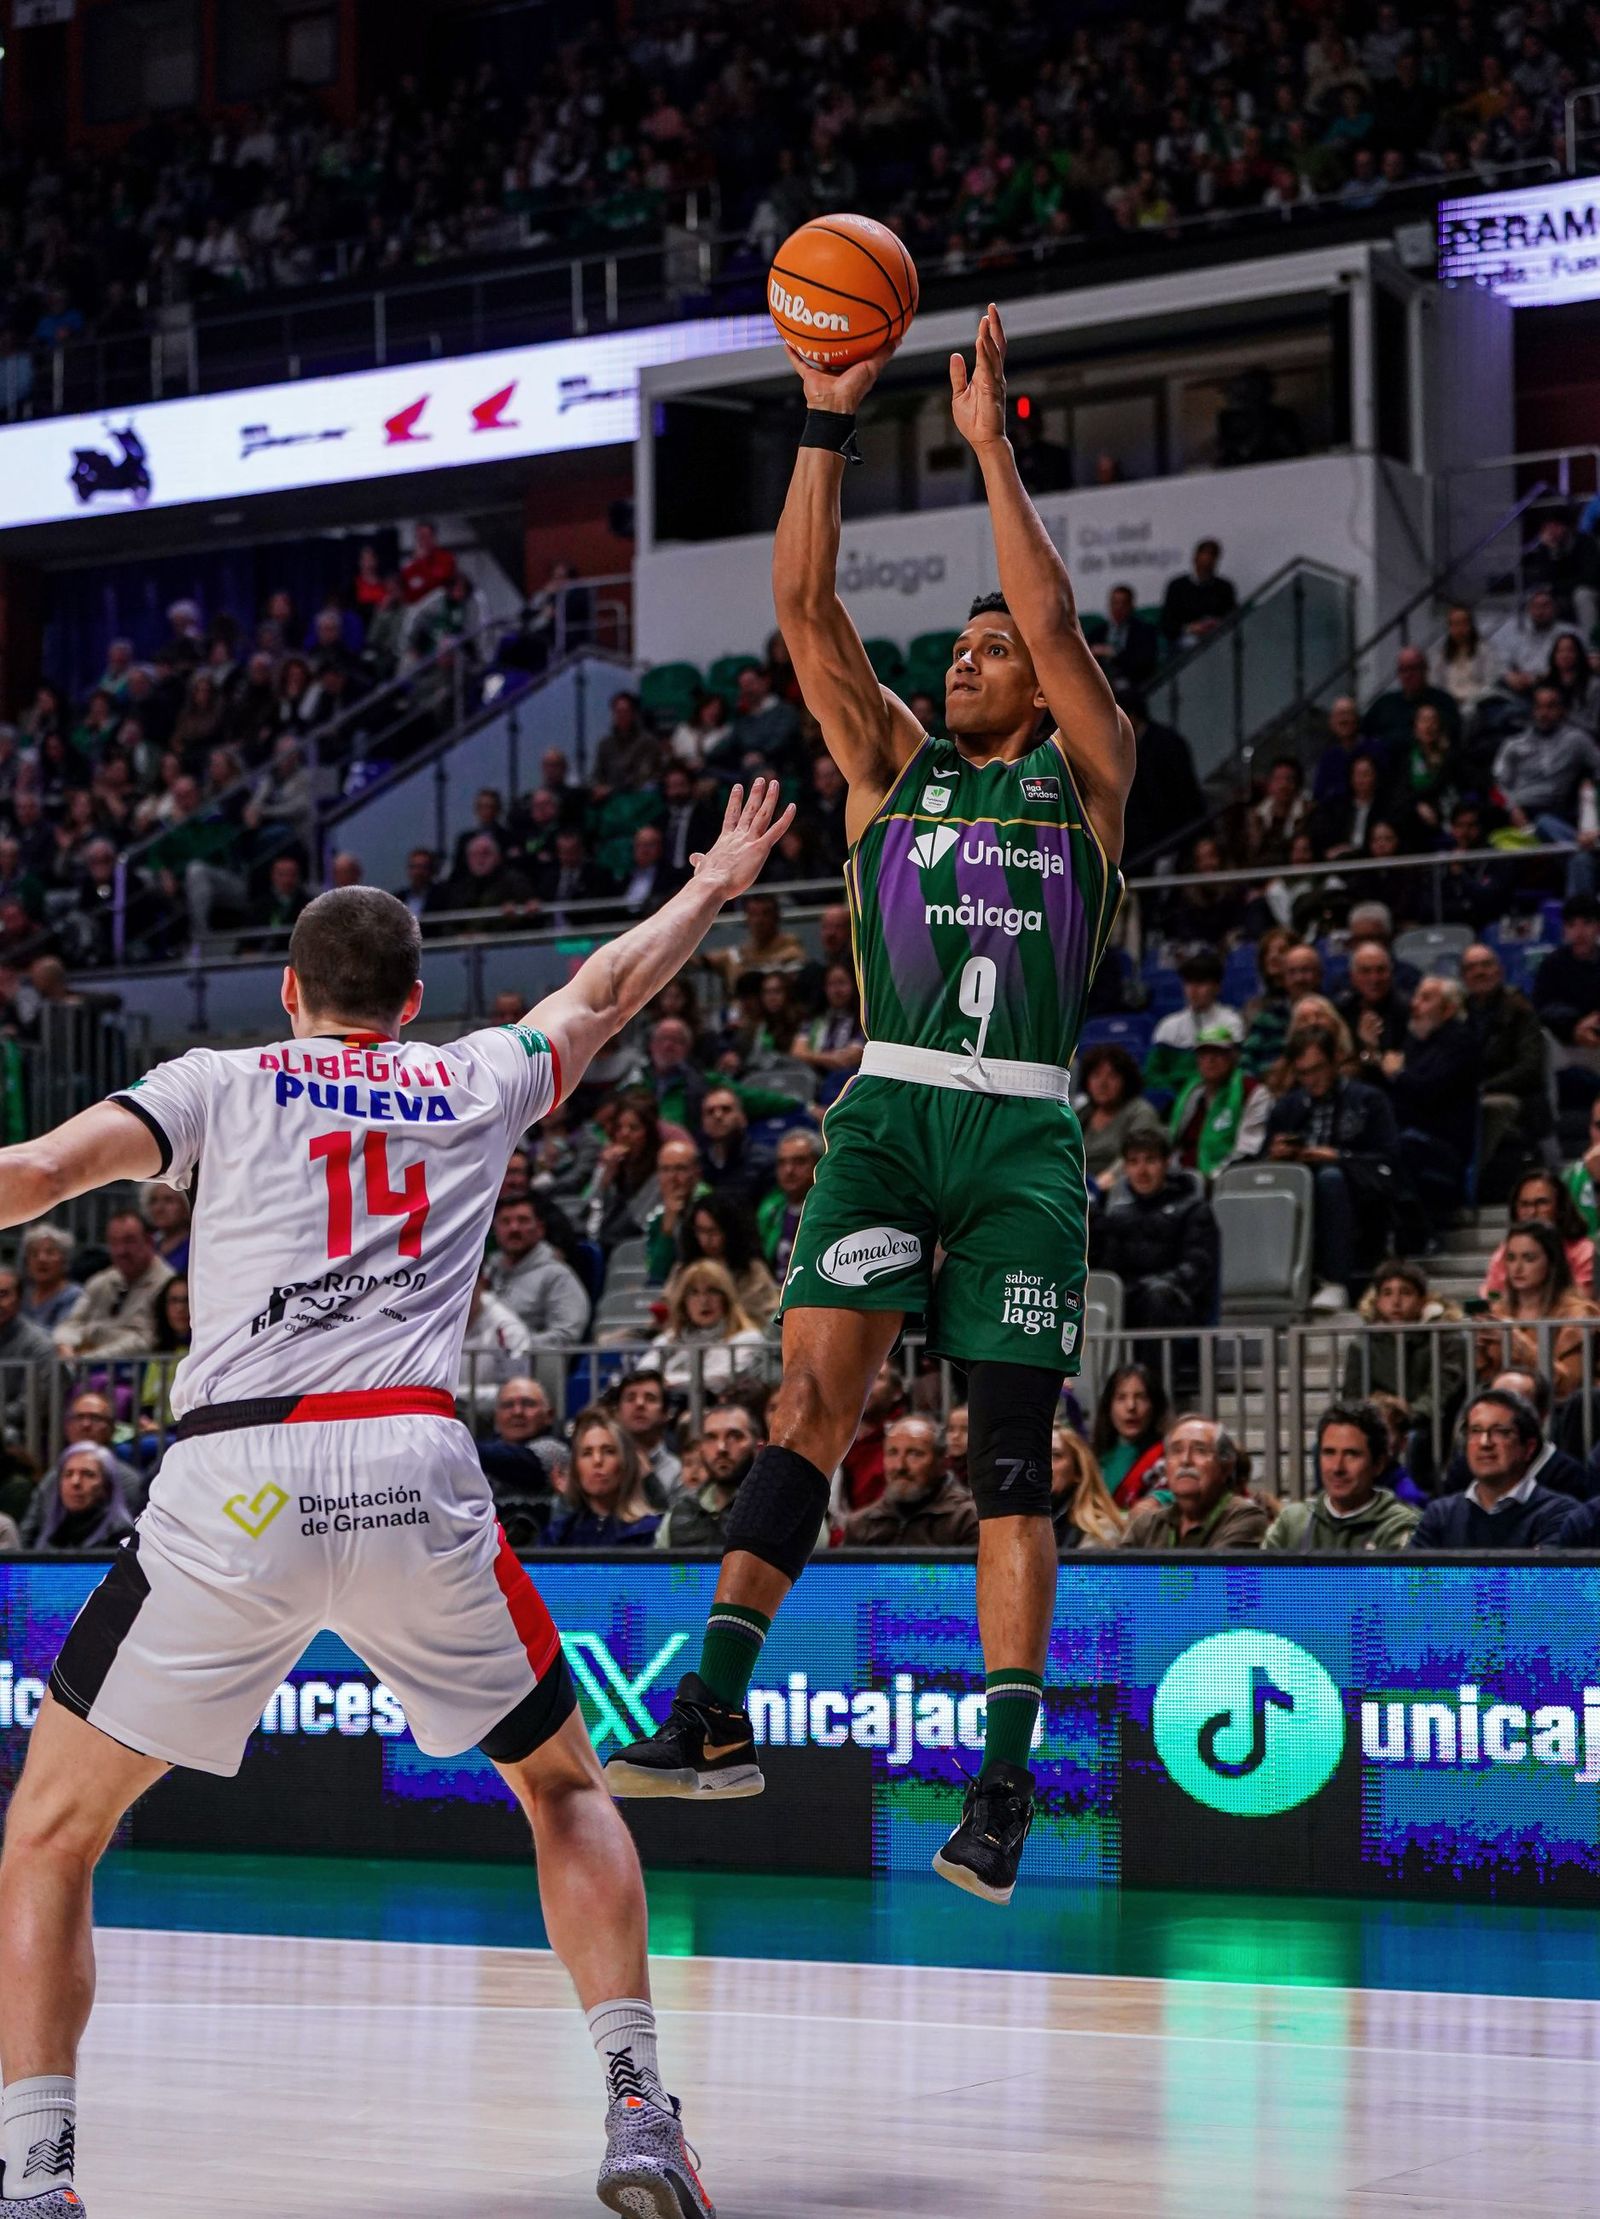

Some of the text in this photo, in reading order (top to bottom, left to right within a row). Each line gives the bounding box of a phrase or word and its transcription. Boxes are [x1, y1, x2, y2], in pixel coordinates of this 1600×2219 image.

[770, 278, 849, 332] Wilson
[1028, 791, 1059, 800] endesa
[963, 840, 1064, 879] Unicaja
[259, 1048, 459, 1088] ALIBEGOVI
[276, 1071, 461, 1123] PULEVA
[309, 1131, 430, 1260] 14
[829, 1232, 918, 1275] famadesa
[1005, 1270, 1043, 1286] sabor
[1001, 1300, 1057, 1335] laga
[299, 1485, 421, 1516] Diputación
[301, 1508, 430, 1536] de Granada
